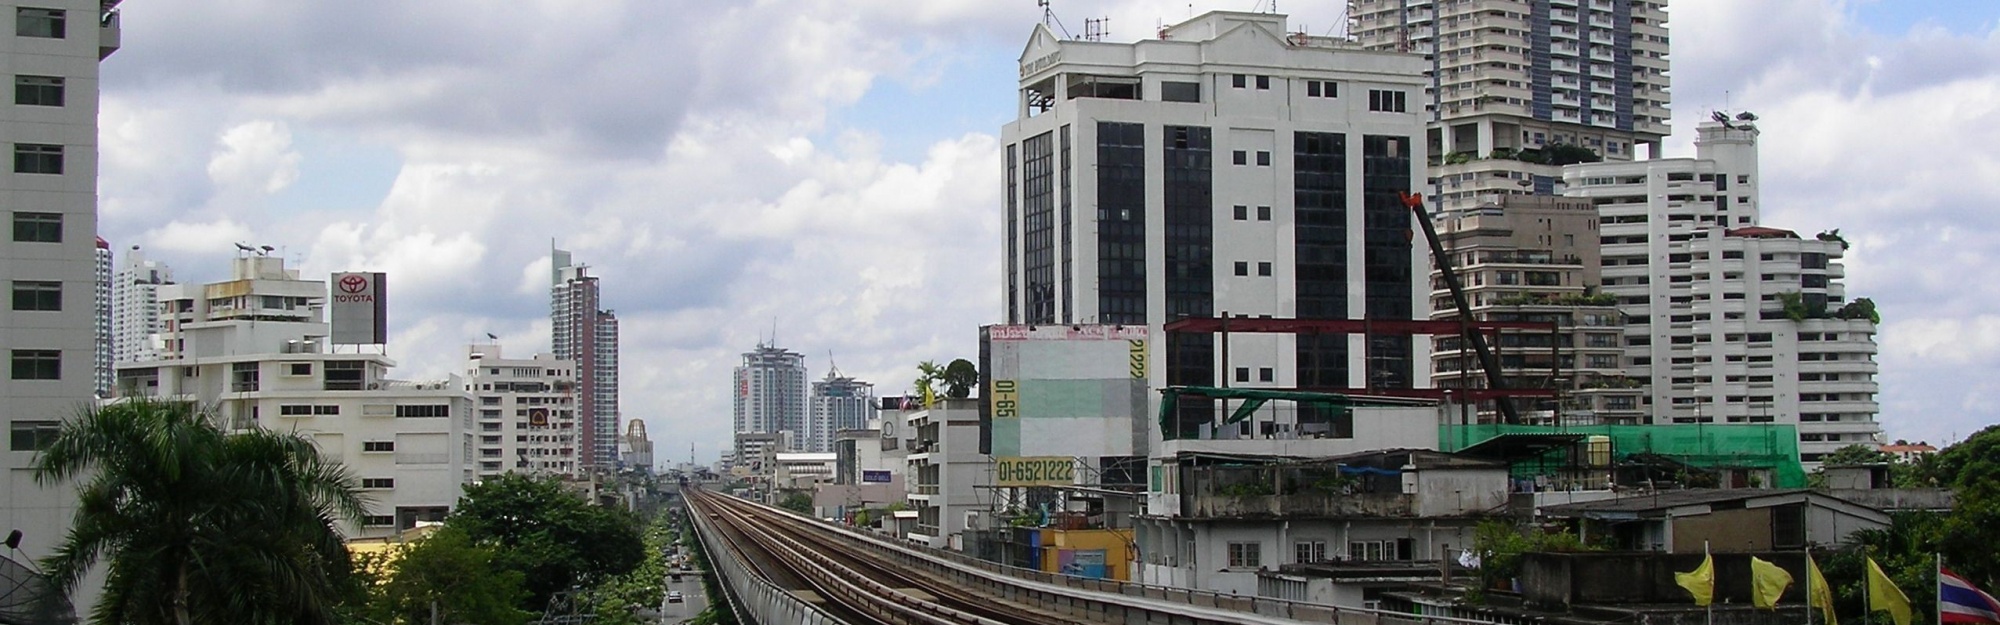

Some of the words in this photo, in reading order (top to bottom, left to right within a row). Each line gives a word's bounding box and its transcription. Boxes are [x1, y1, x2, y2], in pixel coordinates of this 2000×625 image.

[334, 295, 373, 303] TOYOTA
[1129, 339, 1145, 379] 21222
[995, 380, 1016, 417] 01-65
[999, 460, 1074, 481] 01-6521222
